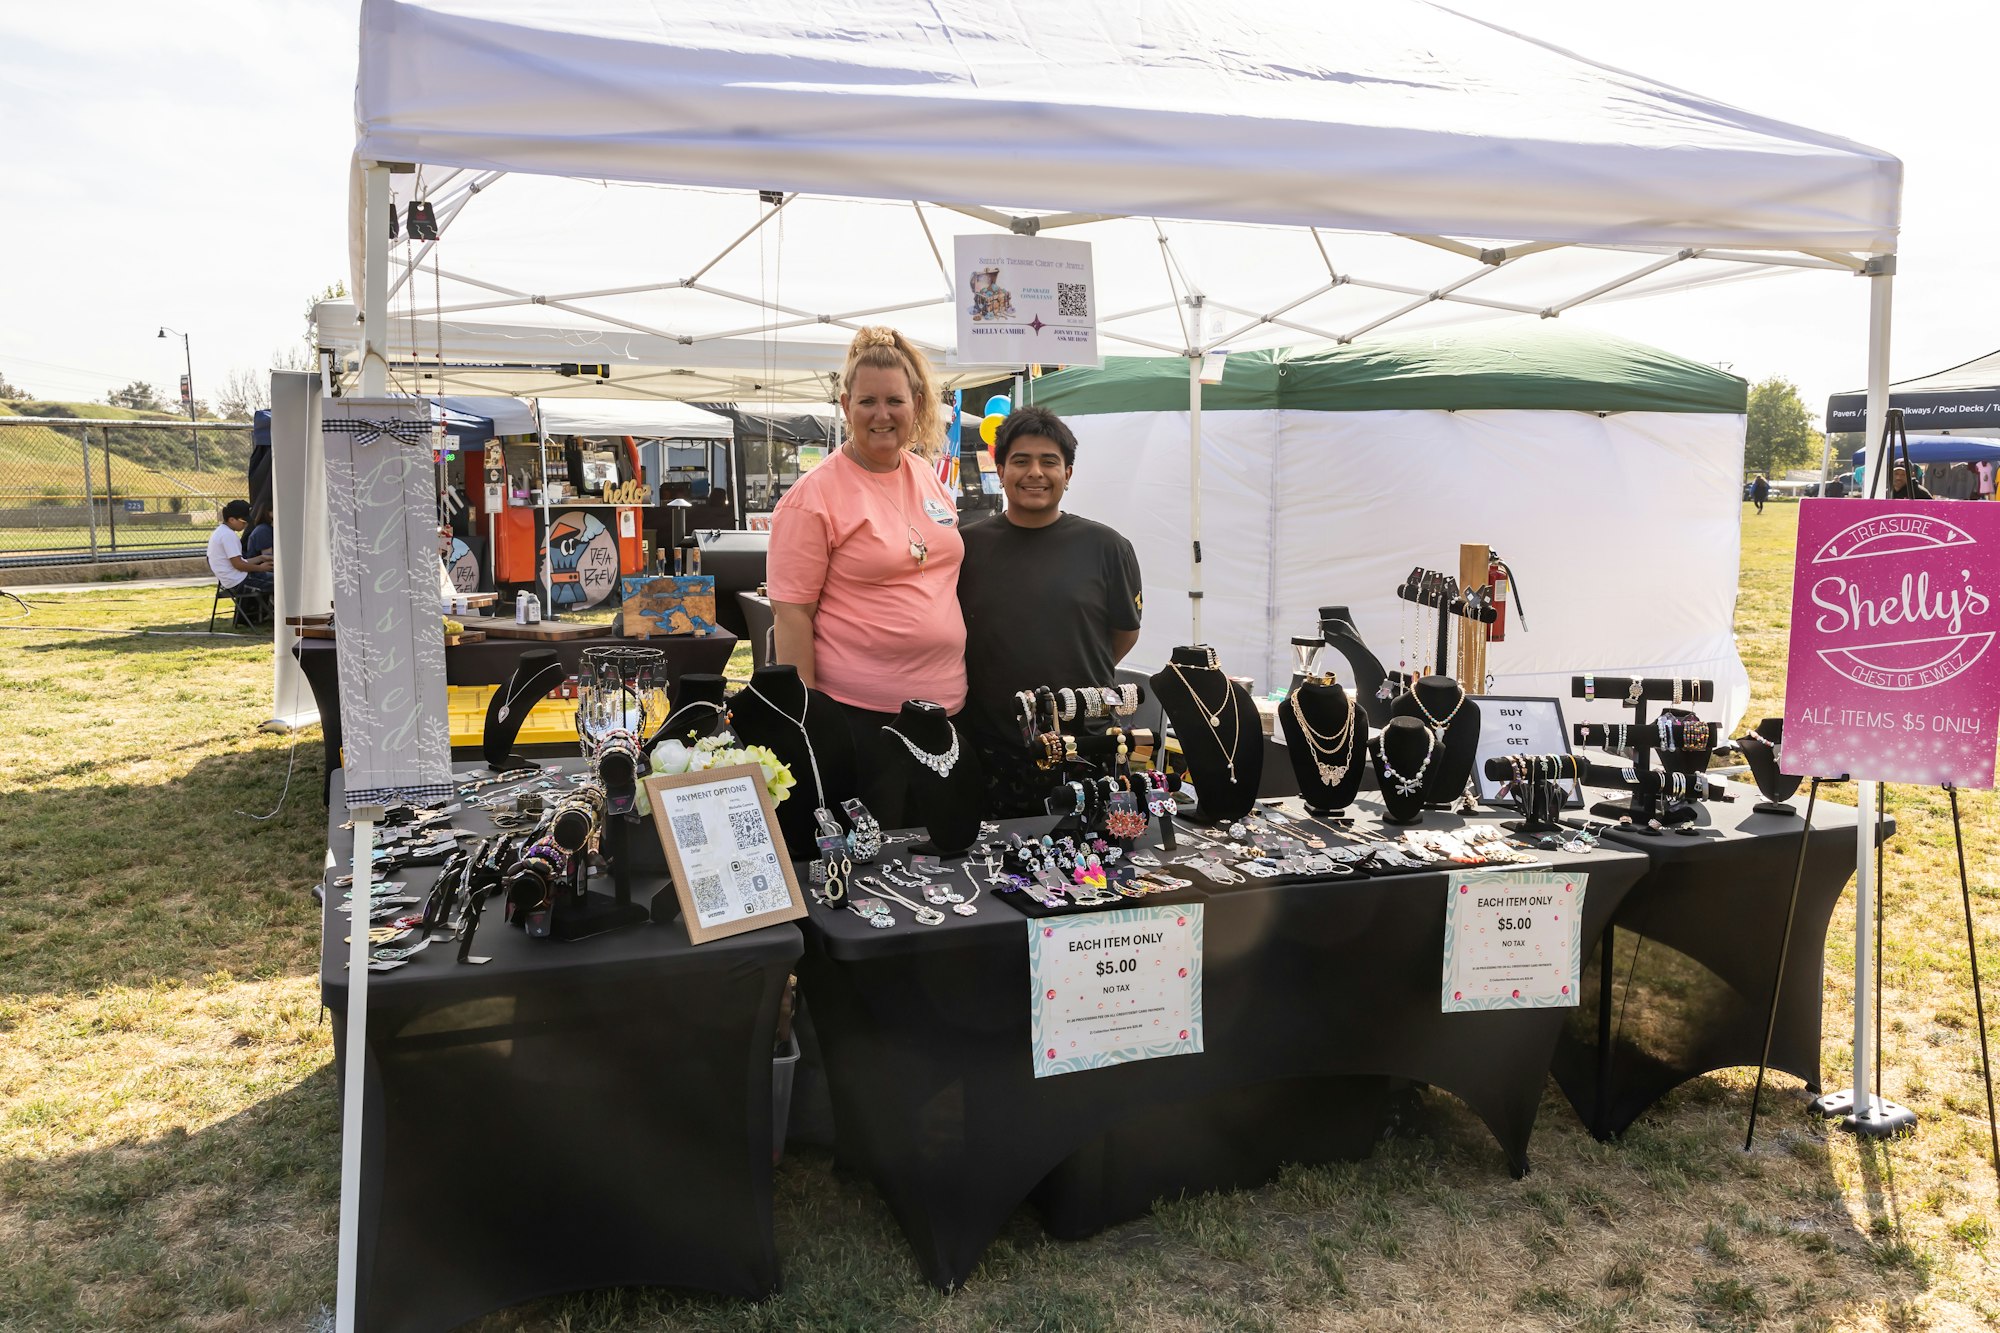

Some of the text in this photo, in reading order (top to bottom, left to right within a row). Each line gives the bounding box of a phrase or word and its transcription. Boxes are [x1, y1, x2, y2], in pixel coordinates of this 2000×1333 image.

[603, 479, 649, 504] hello
[1849, 519, 1932, 544] TREASURE
[584, 567, 617, 587] BREW
[1811, 569, 1990, 634] Shelly's
[1851, 652, 1969, 687] CHEST OF JEWELZ
[1500, 708, 1523, 716] BUY
[1800, 708, 1981, 734] ALL ITEMS $5 ONLY
[1509, 723, 1522, 731] 10
[676, 784, 747, 803] PAYMENT OPTIONS
[1478, 896, 1553, 907] EACH ITEM ONLY
[1498, 917, 1531, 932] $5.00
[1069, 933, 1163, 951] EACH ITEM ONLY
[1096, 959, 1137, 977] $5.00
[1103, 984, 1130, 994] NO TAX
